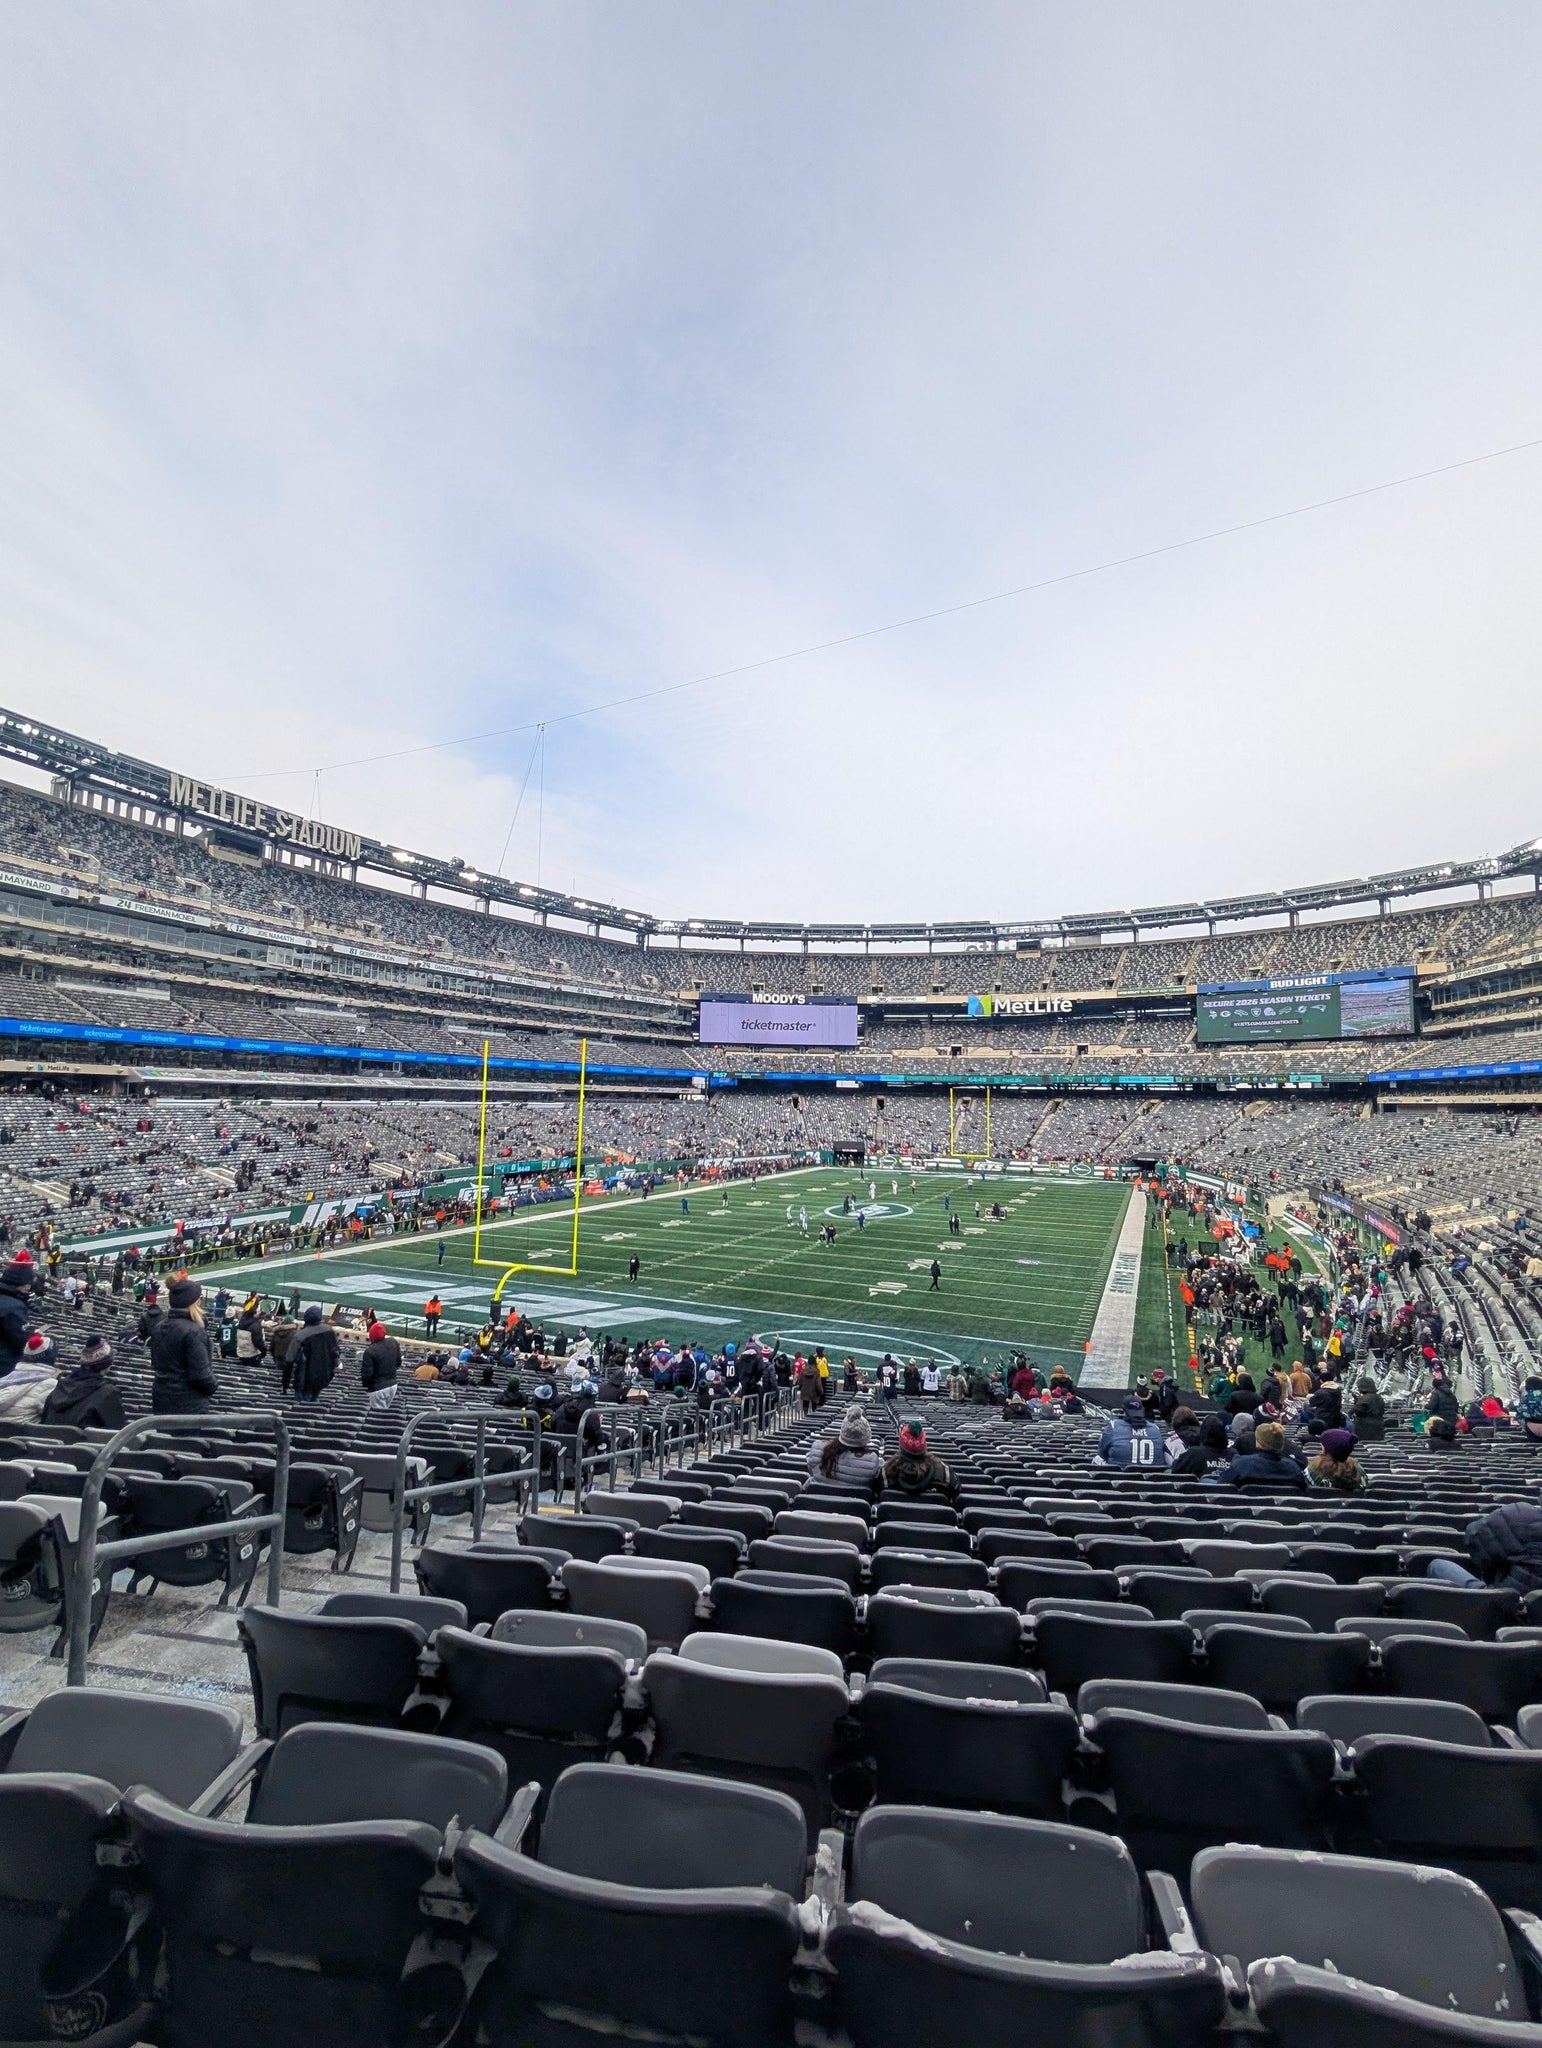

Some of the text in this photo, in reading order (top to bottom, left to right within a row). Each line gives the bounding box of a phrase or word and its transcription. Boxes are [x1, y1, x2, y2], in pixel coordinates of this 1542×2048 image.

[169, 773, 361, 860] METLIFE STADIUM
[3, 874, 51, 891] MAYNARD
[117, 899, 132, 909] 24
[134, 903, 171, 917] FREEMAN
[235, 925, 245, 933] 12
[1270, 976, 1328, 989] BUD LIGHT
[752, 993, 806, 1005] MOODY'S
[994, 996, 1073, 1014] MetLife
[1203, 993, 1332, 1008] SECURE 2026 SEASON TICKETS
[19, 1023, 64, 1034] ticketmaster
[84, 1029, 124, 1039] ticketmaster
[222, 1328, 231, 1341] 8
[726, 1366, 735, 1377] 10
[929, 1374, 936, 1382] 11
[883, 1376, 891, 1387] 10
[1129, 1438, 1154, 1465] 10
